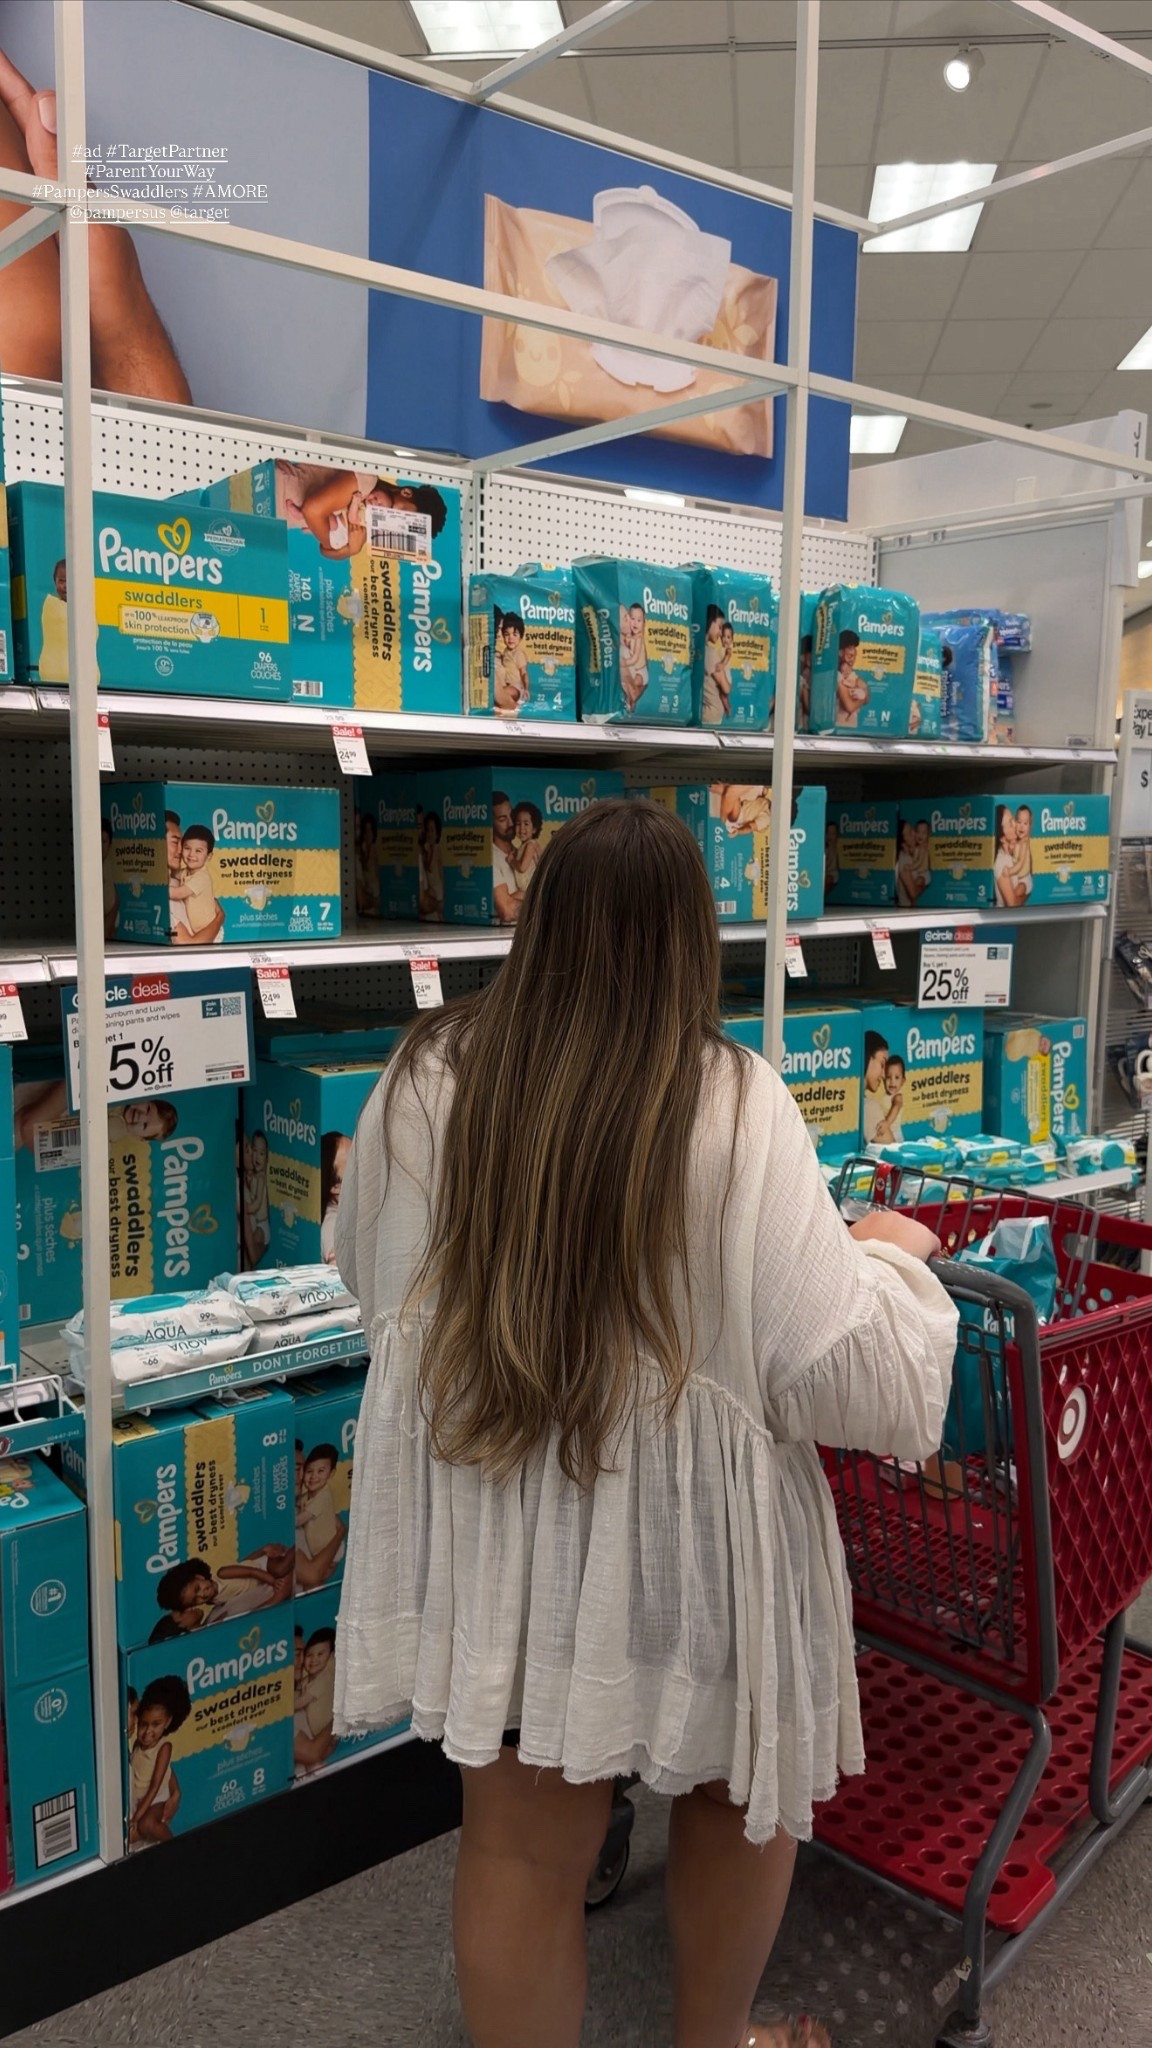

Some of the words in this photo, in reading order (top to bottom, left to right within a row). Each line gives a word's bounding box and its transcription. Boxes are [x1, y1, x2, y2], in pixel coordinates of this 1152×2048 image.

[99, 527, 222, 585] Pampers
[301, 577, 312, 600] 140
[324, 579, 334, 601] plus
[370, 576, 379, 603] best
[125, 591, 203, 610] swaddlers
[520, 594, 575, 624] Pampers
[643, 587, 688, 620] Pampers
[259, 608, 266, 624] 1
[326, 603, 334, 632] sèches
[380, 561, 397, 661] swaddlers
[408, 558, 442, 673] Pampers
[728, 600, 769, 627] Pampers
[125, 621, 141, 630] skin
[145, 623, 189, 636] protection
[157, 616, 188, 624] LEAKPROOF
[297, 615, 315, 632] N
[858, 614, 904, 637] Pampers
[370, 608, 380, 658] dryness
[525, 631, 572, 644] swaddlers
[648, 627, 687, 642] swaddlers
[133, 638, 162, 646] protection
[733, 640, 764, 651] swaddlers
[258, 652, 271, 663] 96
[253, 662, 278, 672] DIAPERS
[553, 692, 562, 705] 4
[673, 695, 679, 706] 3
[749, 704, 754, 717] 1
[881, 711, 891, 722] N
[332, 727, 355, 737] Sale!
[689, 792, 699, 804] 4
[378, 800, 416, 826] Pampers
[443, 796, 488, 824] Pampers
[111, 803, 156, 835] Pampers
[213, 809, 297, 845] Pampers
[840, 813, 889, 836] Pampers
[931, 810, 987, 834] Pampers
[1041, 808, 1087, 835] Pampers
[715, 826, 724, 843] 66
[115, 844, 155, 857] swaddlers
[935, 840, 982, 850] swaddlers
[1044, 841, 1083, 852] swaddlers
[220, 853, 293, 869] swaddlers
[233, 869, 254, 878] best
[257, 870, 292, 880] dryness
[720, 877, 730, 888] 4
[1098, 876, 1104, 888] 3
[881, 885, 888, 896] 3
[978, 885, 985, 896] 3
[292, 905, 308, 916] 44
[320, 902, 331, 920] 7
[482, 896, 488, 910] 5
[153, 905, 161, 925] 7
[239, 913, 255, 922] plus
[256, 912, 278, 922] sèches
[124, 920, 134, 931] 44
[257, 968, 281, 979] Sale!
[410, 961, 431, 970] Sale!
[132, 981, 170, 999] deals
[952, 986, 969, 1000] off
[150, 1005, 165, 1013] Luvs
[126, 1018, 144, 1027] pants
[146, 1015, 159, 1023] and
[161, 1013, 180, 1022] wipes
[907, 1027, 975, 1063] Pampers
[781, 1046, 851, 1078] ampers
[142, 1063, 173, 1085] off
[911, 1072, 970, 1092] swaddlers
[792, 1086, 845, 1103] addlers
[921, 1092, 937, 1101] best
[940, 1086, 969, 1099] dryness
[1051, 1041, 1071, 1135] Pampers
[809, 1103, 844, 1120] dryness
[263, 1100, 316, 1146] Pampers
[269, 1165, 309, 1188] swaddlers
[109, 1177, 121, 1215] best
[42, 1197, 57, 1224] plus
[123, 1154, 145, 1277] swaddlers
[157, 1136, 204, 1278] Pampers
[44, 1226, 55, 1263] sèches
[109, 1217, 122, 1278] dryness
[299, 1289, 335, 1304] AQUA
[145, 1325, 187, 1341] AQUA
[168, 1338, 207, 1352] AQUA
[273, 1336, 301, 1349] AQUA
[209, 1370, 242, 1385] Pampers
[253, 1353, 292, 1373] DON'T
[295, 1343, 342, 1362] FORGET
[263, 1433, 278, 1447] 8
[208, 1460, 218, 1506] dryness
[191, 1461, 208, 1553] swaddlers
[277, 1495, 286, 1510] 60
[146, 1463, 182, 1573] Pampers
[209, 1508, 217, 1535] best
[187, 1639, 288, 1696] Pampers
[194, 1680, 282, 1722] swaddlers
[209, 1710, 234, 1727] best
[238, 1693, 281, 1715] dryness
[217, 1716, 248, 1732] comfort
[249, 1709, 266, 1720] ever
[217, 1758, 233, 1772] plus
[253, 1768, 265, 1785] 8
[222, 1779, 237, 1793] 60
